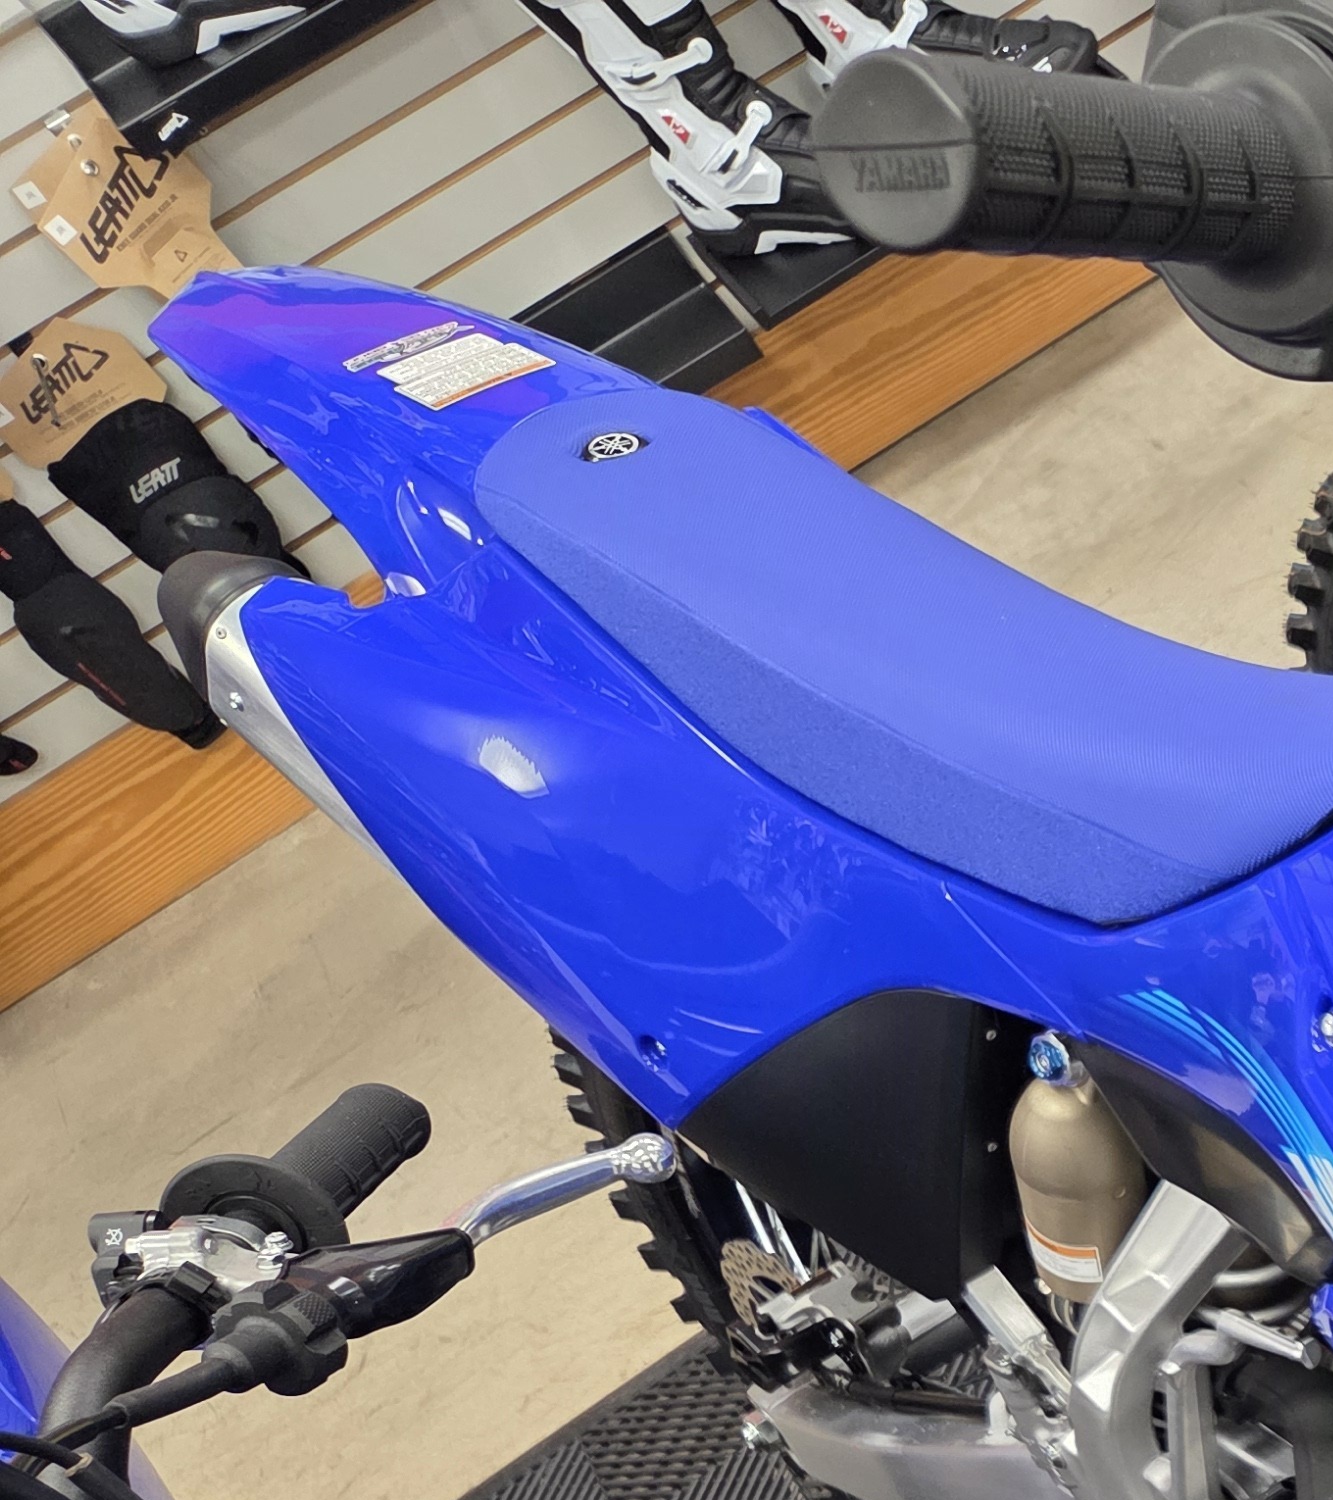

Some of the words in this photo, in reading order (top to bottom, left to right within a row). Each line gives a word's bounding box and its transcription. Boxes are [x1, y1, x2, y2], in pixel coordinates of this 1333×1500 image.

[849, 153, 950, 193] YAMAHA
[80, 152, 152, 264] LEATT
[129, 456, 181, 504] LEATT
